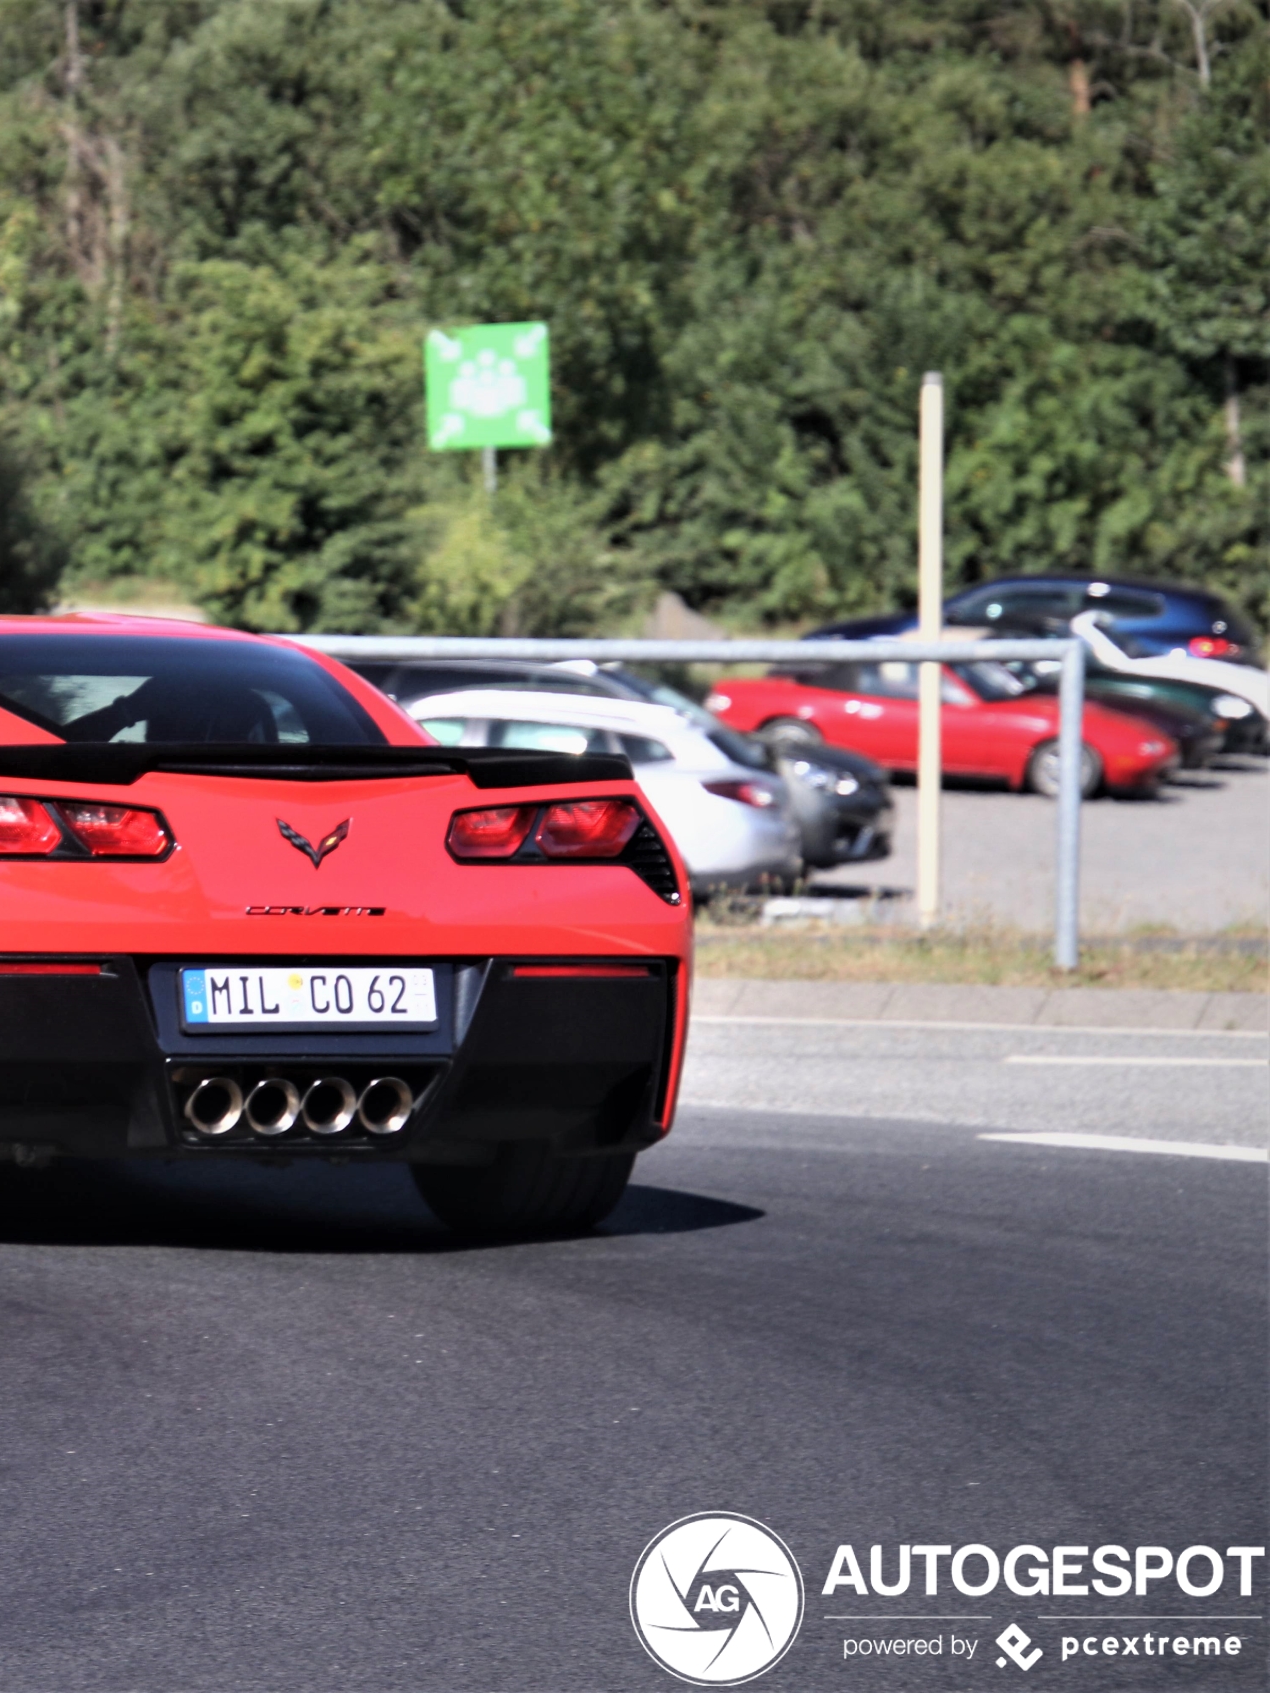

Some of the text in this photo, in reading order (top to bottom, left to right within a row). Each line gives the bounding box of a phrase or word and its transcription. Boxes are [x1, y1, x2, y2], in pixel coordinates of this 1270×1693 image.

[191, 1001, 203, 1014] D
[211, 974, 408, 1015] MIL CO 62
